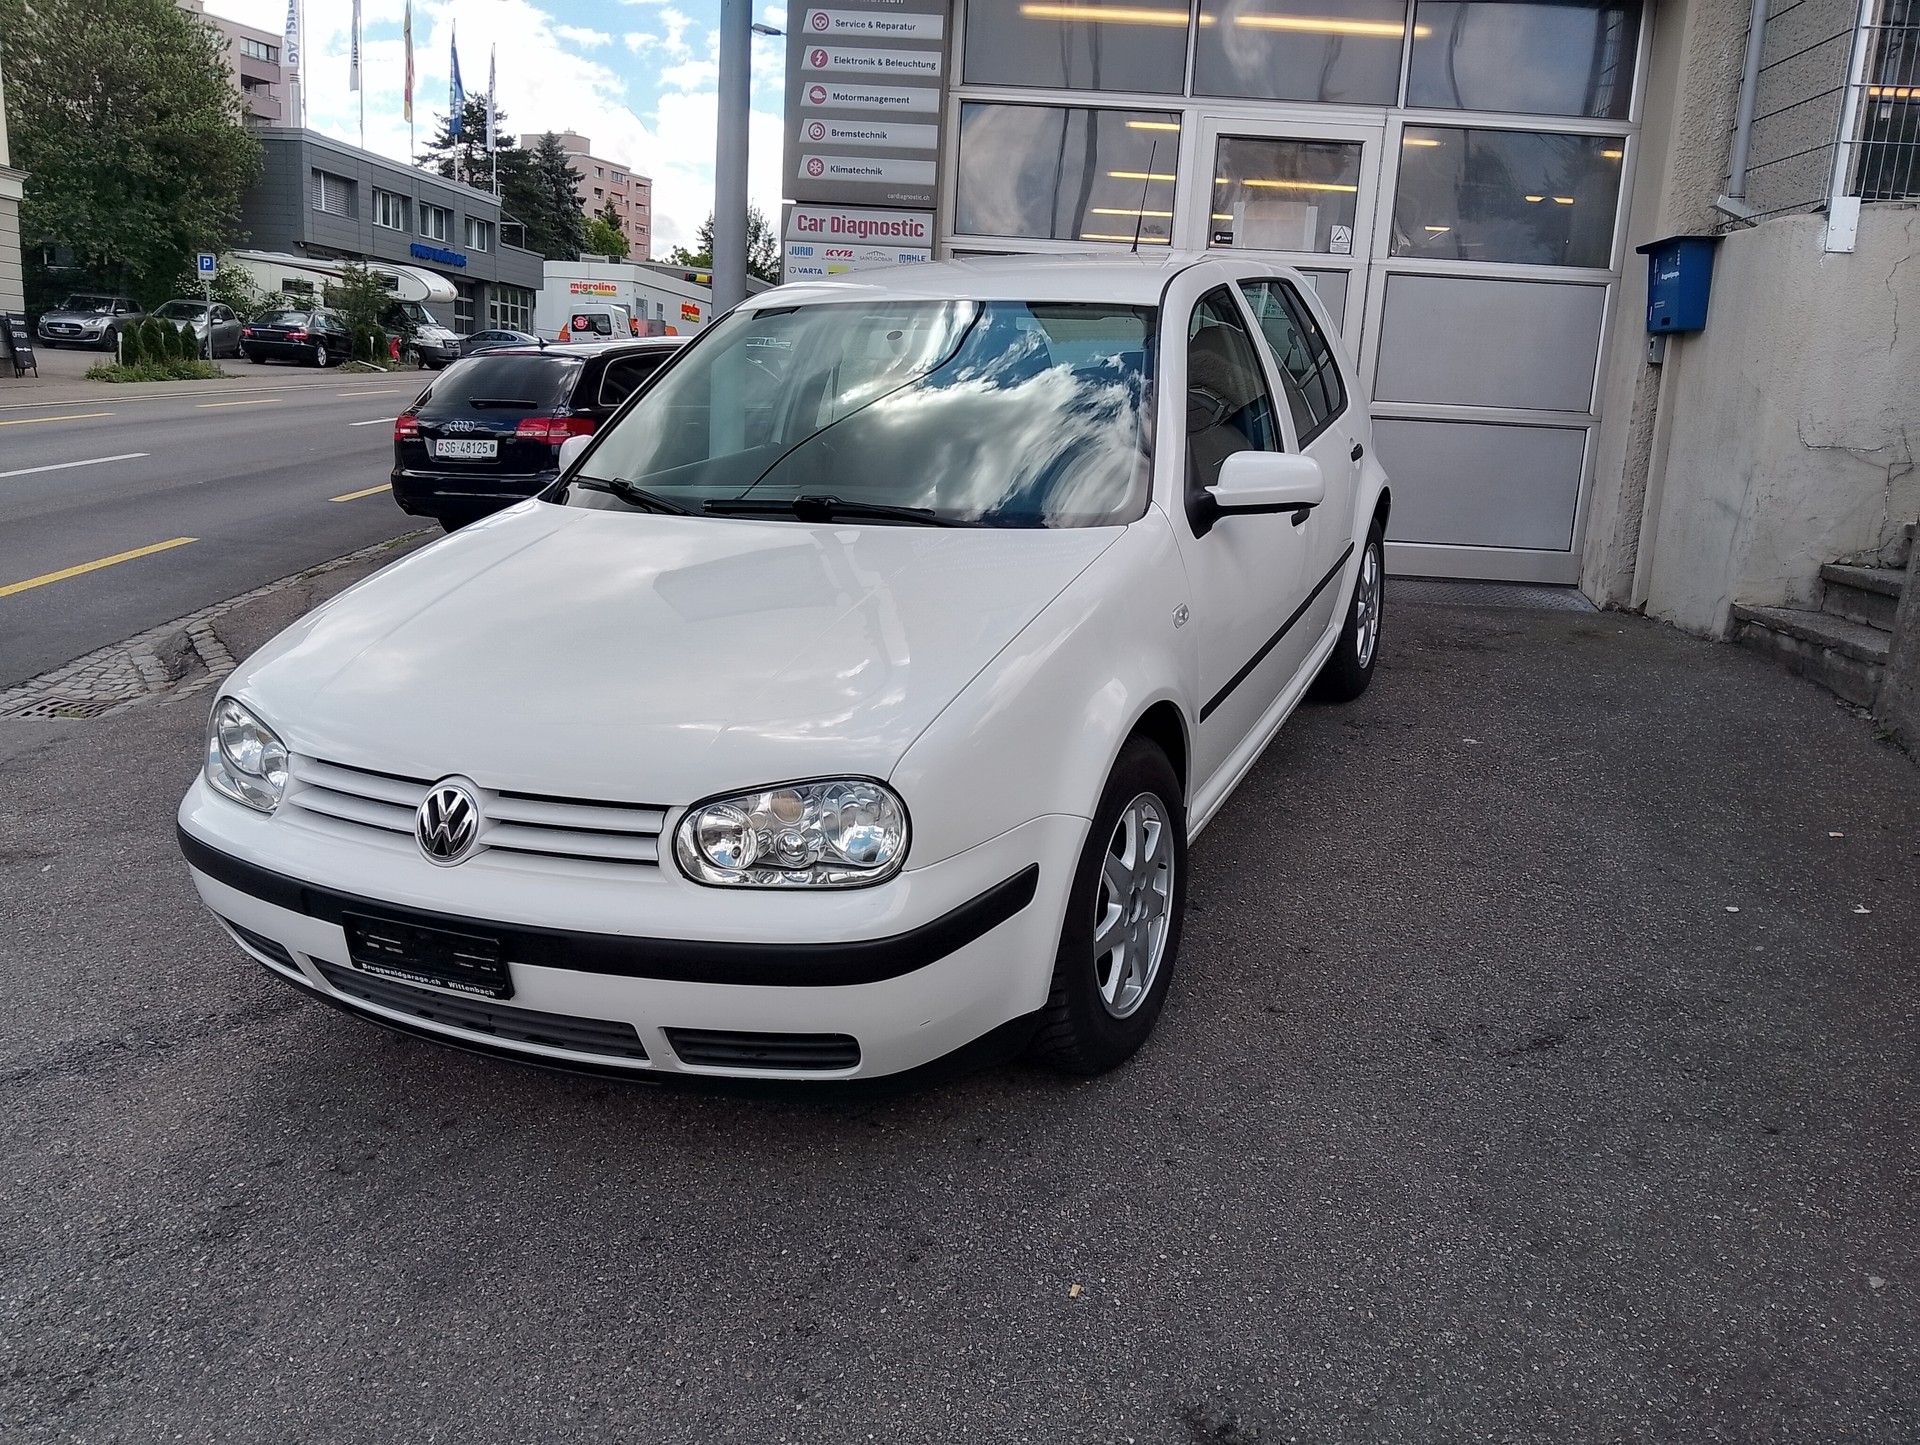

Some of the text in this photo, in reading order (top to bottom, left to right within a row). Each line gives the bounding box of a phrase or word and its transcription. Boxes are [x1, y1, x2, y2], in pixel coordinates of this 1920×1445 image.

[835, 19, 916, 31] Service & Reparatur
[286, 41, 299, 63] AG
[834, 56, 876, 66] Elektronik
[885, 59, 937, 70] Beleuchtung
[832, 92, 910, 105] Motormanagement
[831, 129, 888, 140] Bremstechnik
[830, 165, 883, 176] Klimatechnik
[887, 193, 931, 201] cardiagnostic.ch
[797, 214, 925, 239] Car Diagnostic
[788, 245, 814, 257] JURID
[825, 248, 853, 258] KYB
[203, 258, 211, 269] P
[859, 255, 893, 263] SAINT-GOBAIN
[898, 253, 927, 264] MAHLE
[797, 266, 823, 275] VARTA
[570, 281, 618, 292] migrolino
[447, 980, 496, 997] Wittenbach
